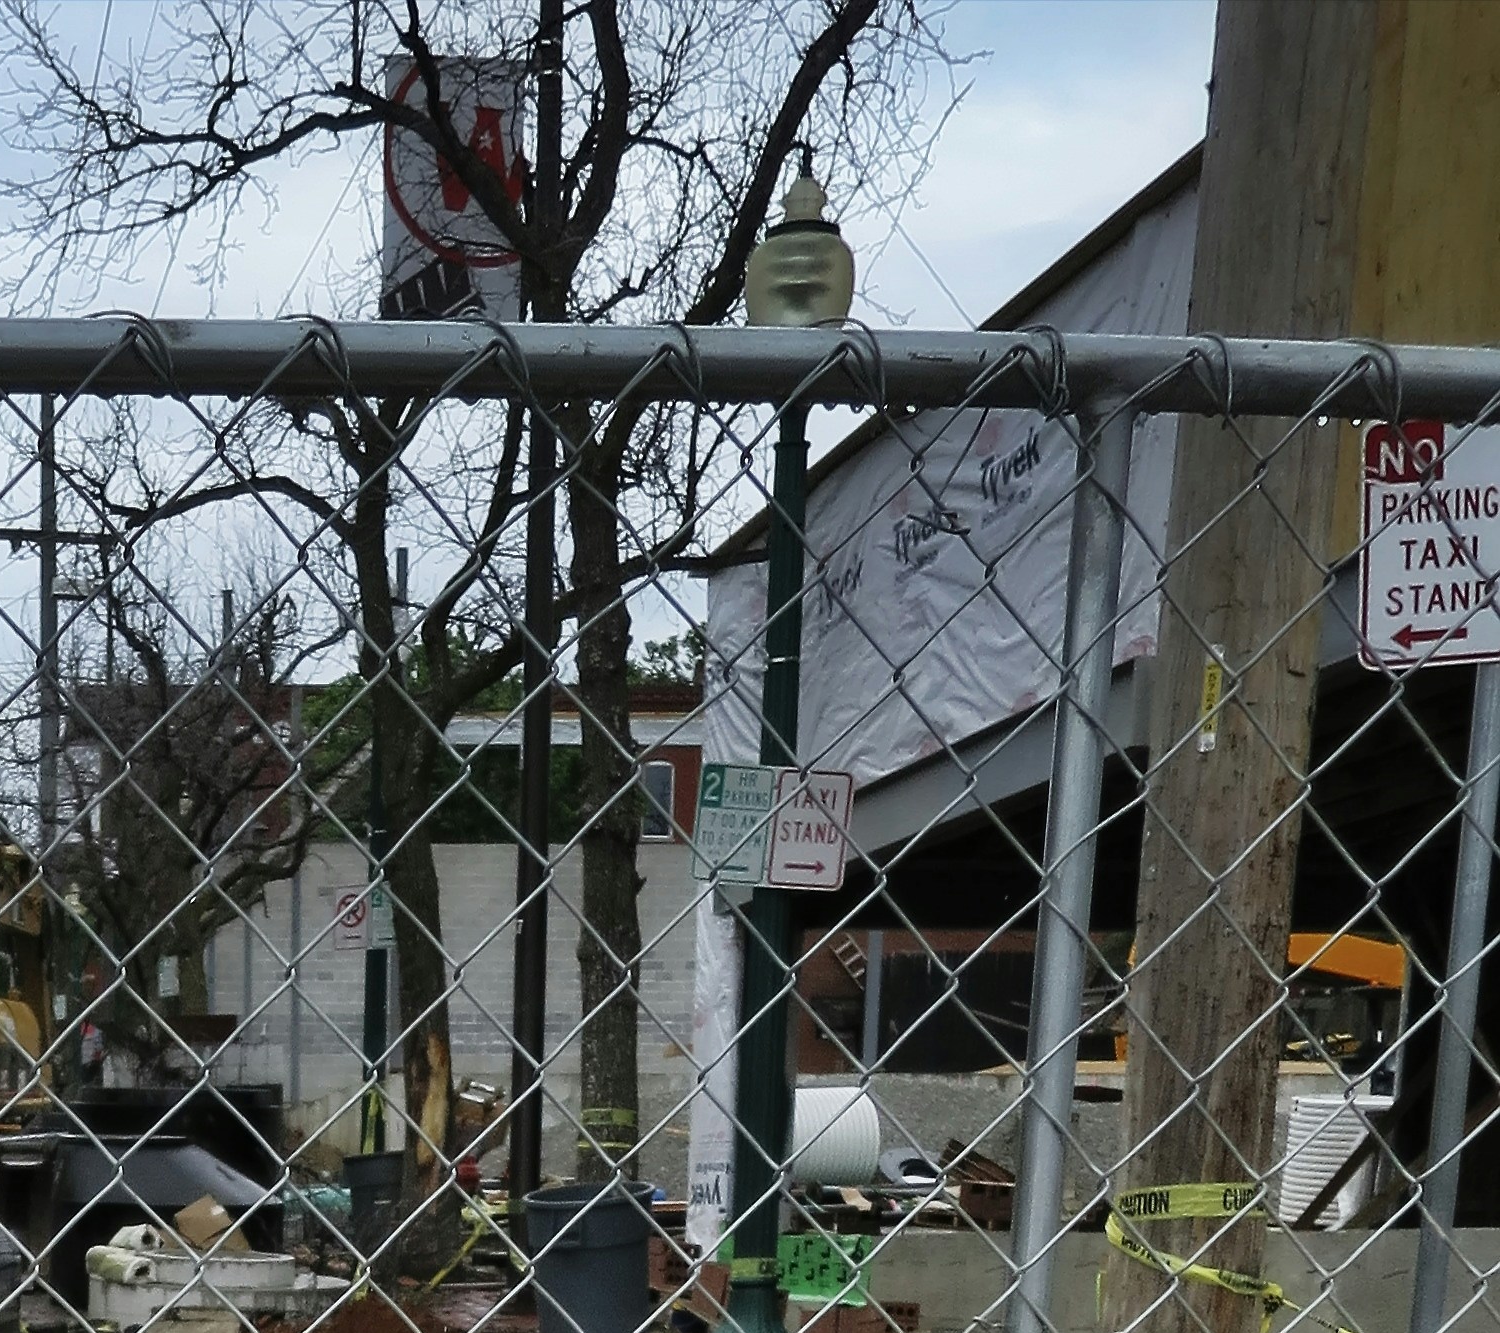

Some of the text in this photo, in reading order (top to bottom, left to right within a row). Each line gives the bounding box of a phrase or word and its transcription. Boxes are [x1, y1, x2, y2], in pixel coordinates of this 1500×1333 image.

[979, 427, 1040, 505] Tyvek
[1379, 437, 1439, 477] NO
[1381, 486, 1499, 526] PARKING
[1399, 536, 1479, 571] TAXI
[704, 772, 721, 801] 2
[792, 786, 838, 811] TAXI
[779, 821, 839, 845] STAND
